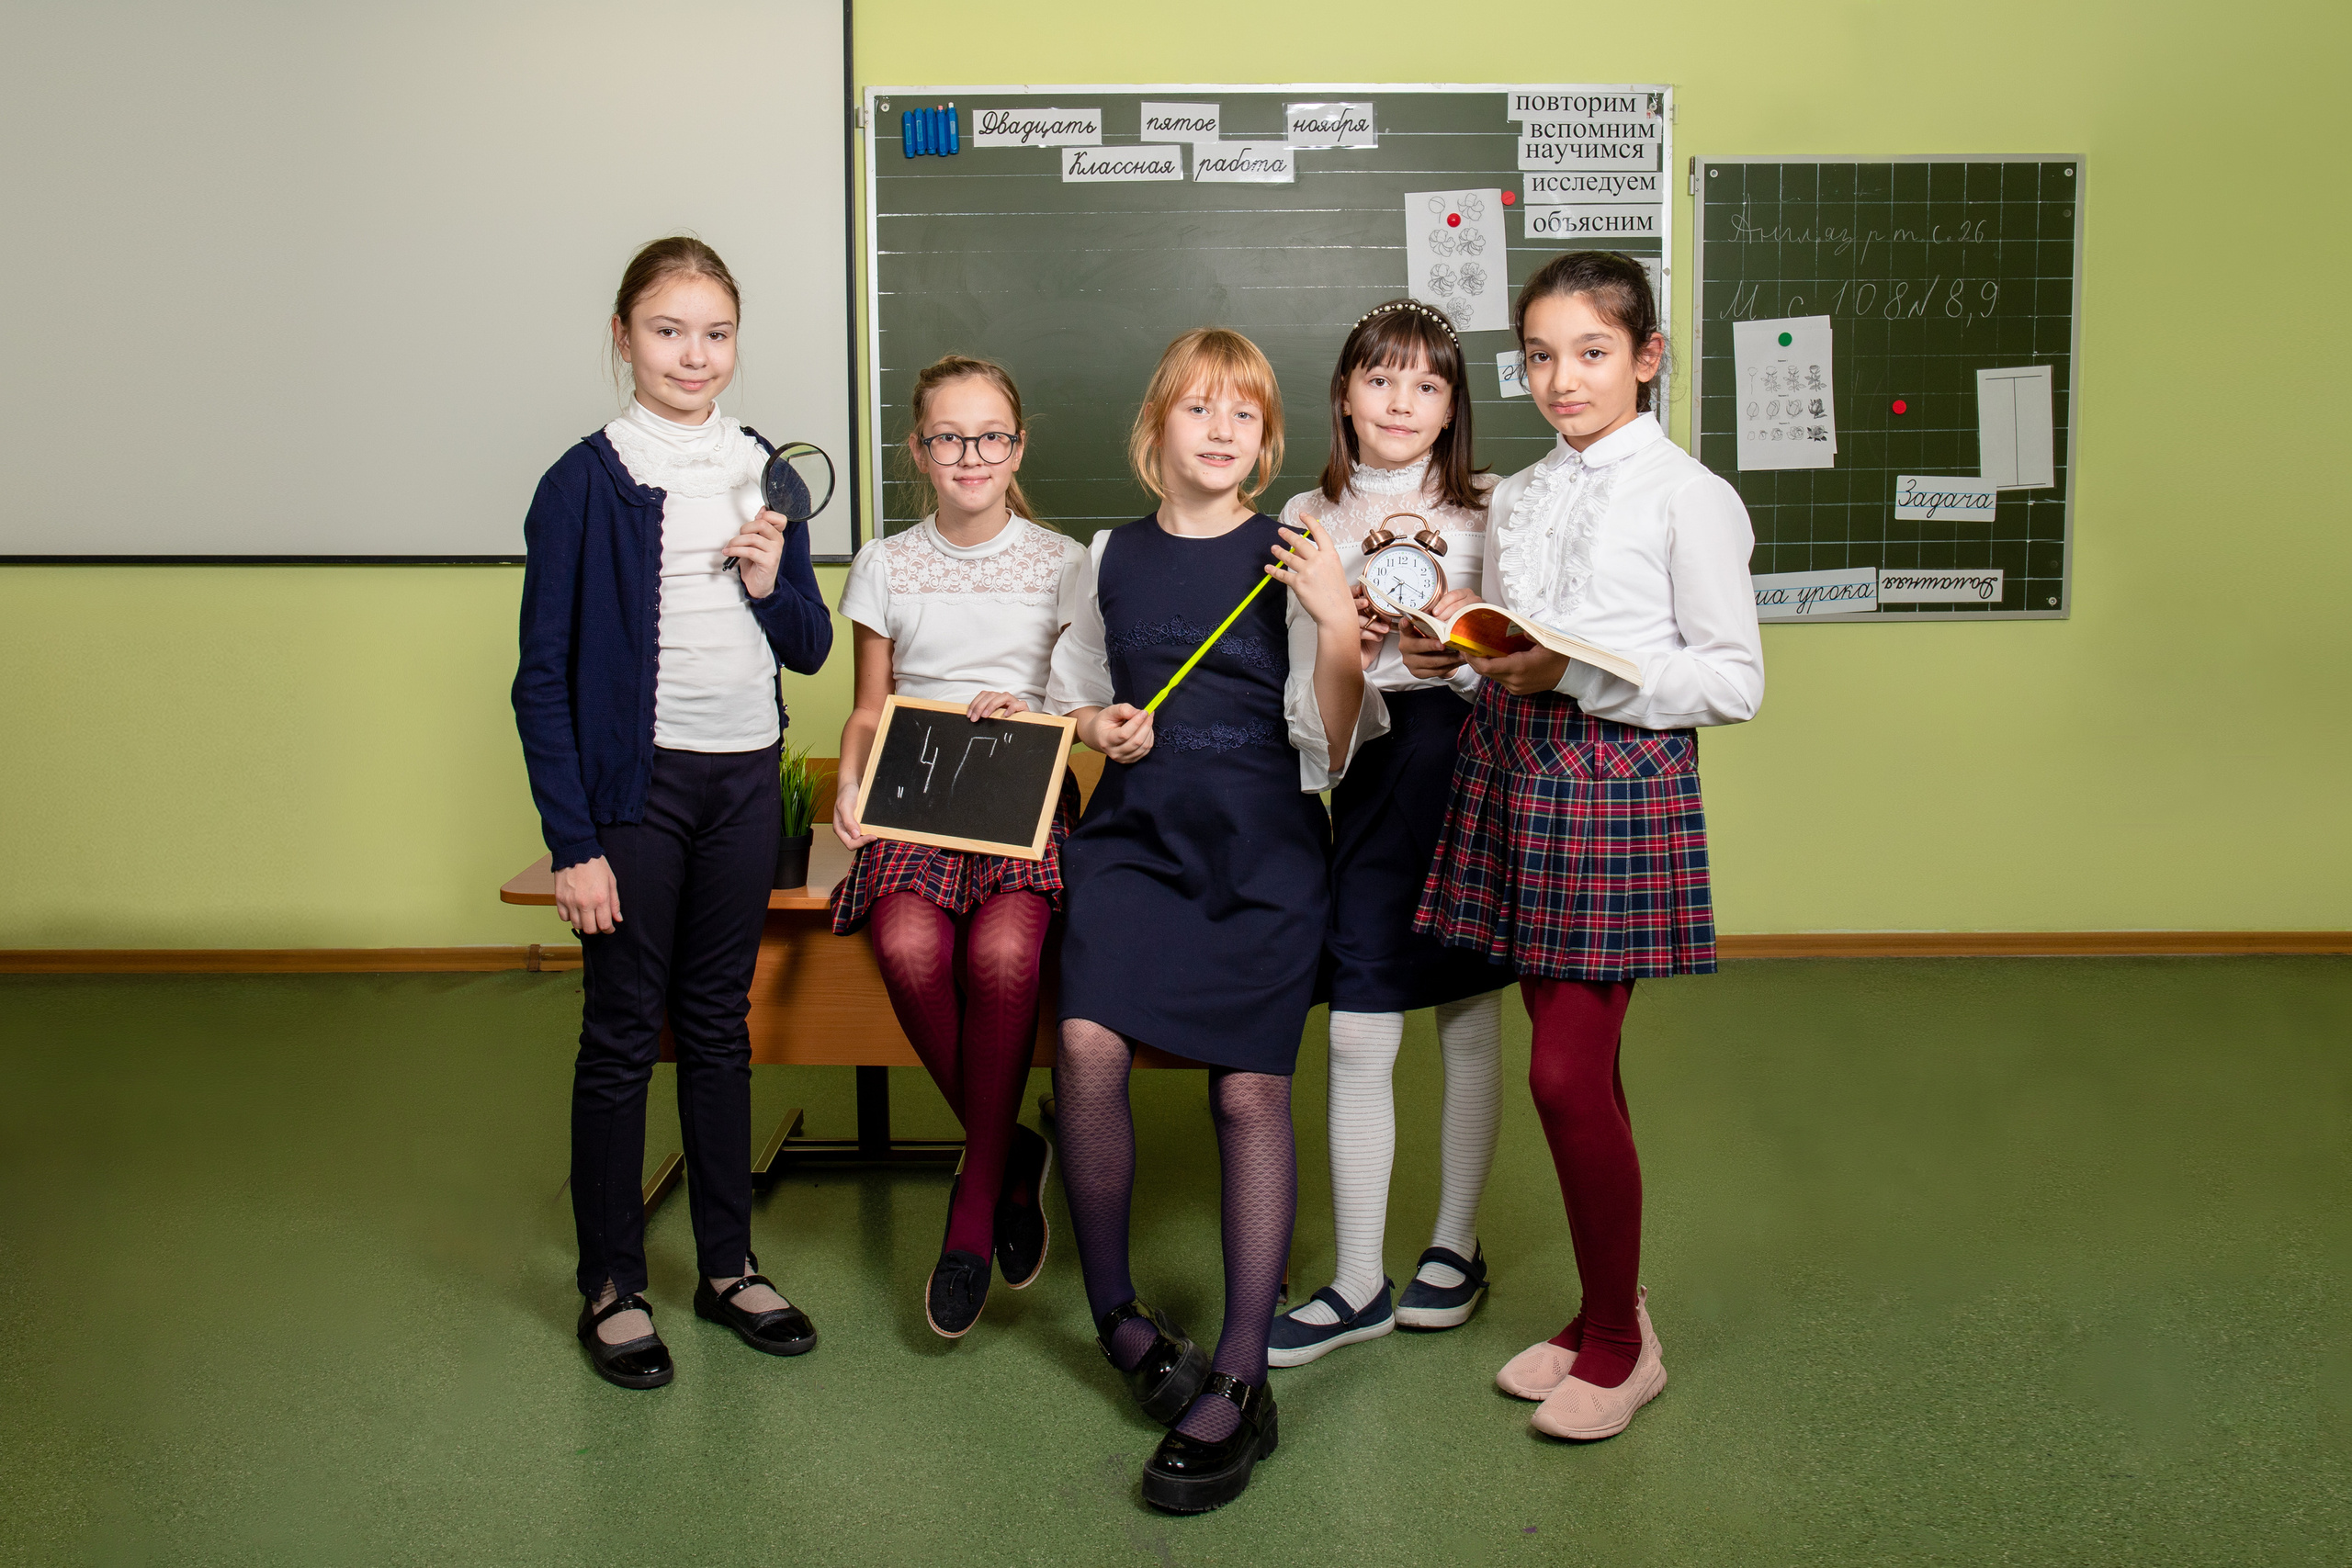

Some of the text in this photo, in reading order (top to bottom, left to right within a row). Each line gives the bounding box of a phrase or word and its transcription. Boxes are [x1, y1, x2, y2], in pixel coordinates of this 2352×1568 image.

[1516, 95, 1637, 118] повторим
[978, 107, 1370, 143] Двадцать пятое ноября
[1530, 122, 1656, 139] вспомним
[1068, 147, 1287, 181] Классная работа
[1525, 142, 1645, 164] научимся
[1532, 175, 1657, 197] исследуем
[1532, 209, 1654, 232] объясним
[1898, 479, 1994, 519] Задача
[1377, 567, 1387, 576] 10
[1386, 558, 1395, 568] 11
[1398, 556, 1408, 565] 12
[1373, 578, 1380, 587] 9
[1420, 567, 1427, 577] 2
[1423, 579, 1430, 588] 3
[1882, 576, 1998, 600] Домашняя
[1409, 599, 1417, 608] 5
[1796, 582, 1874, 615] урока
